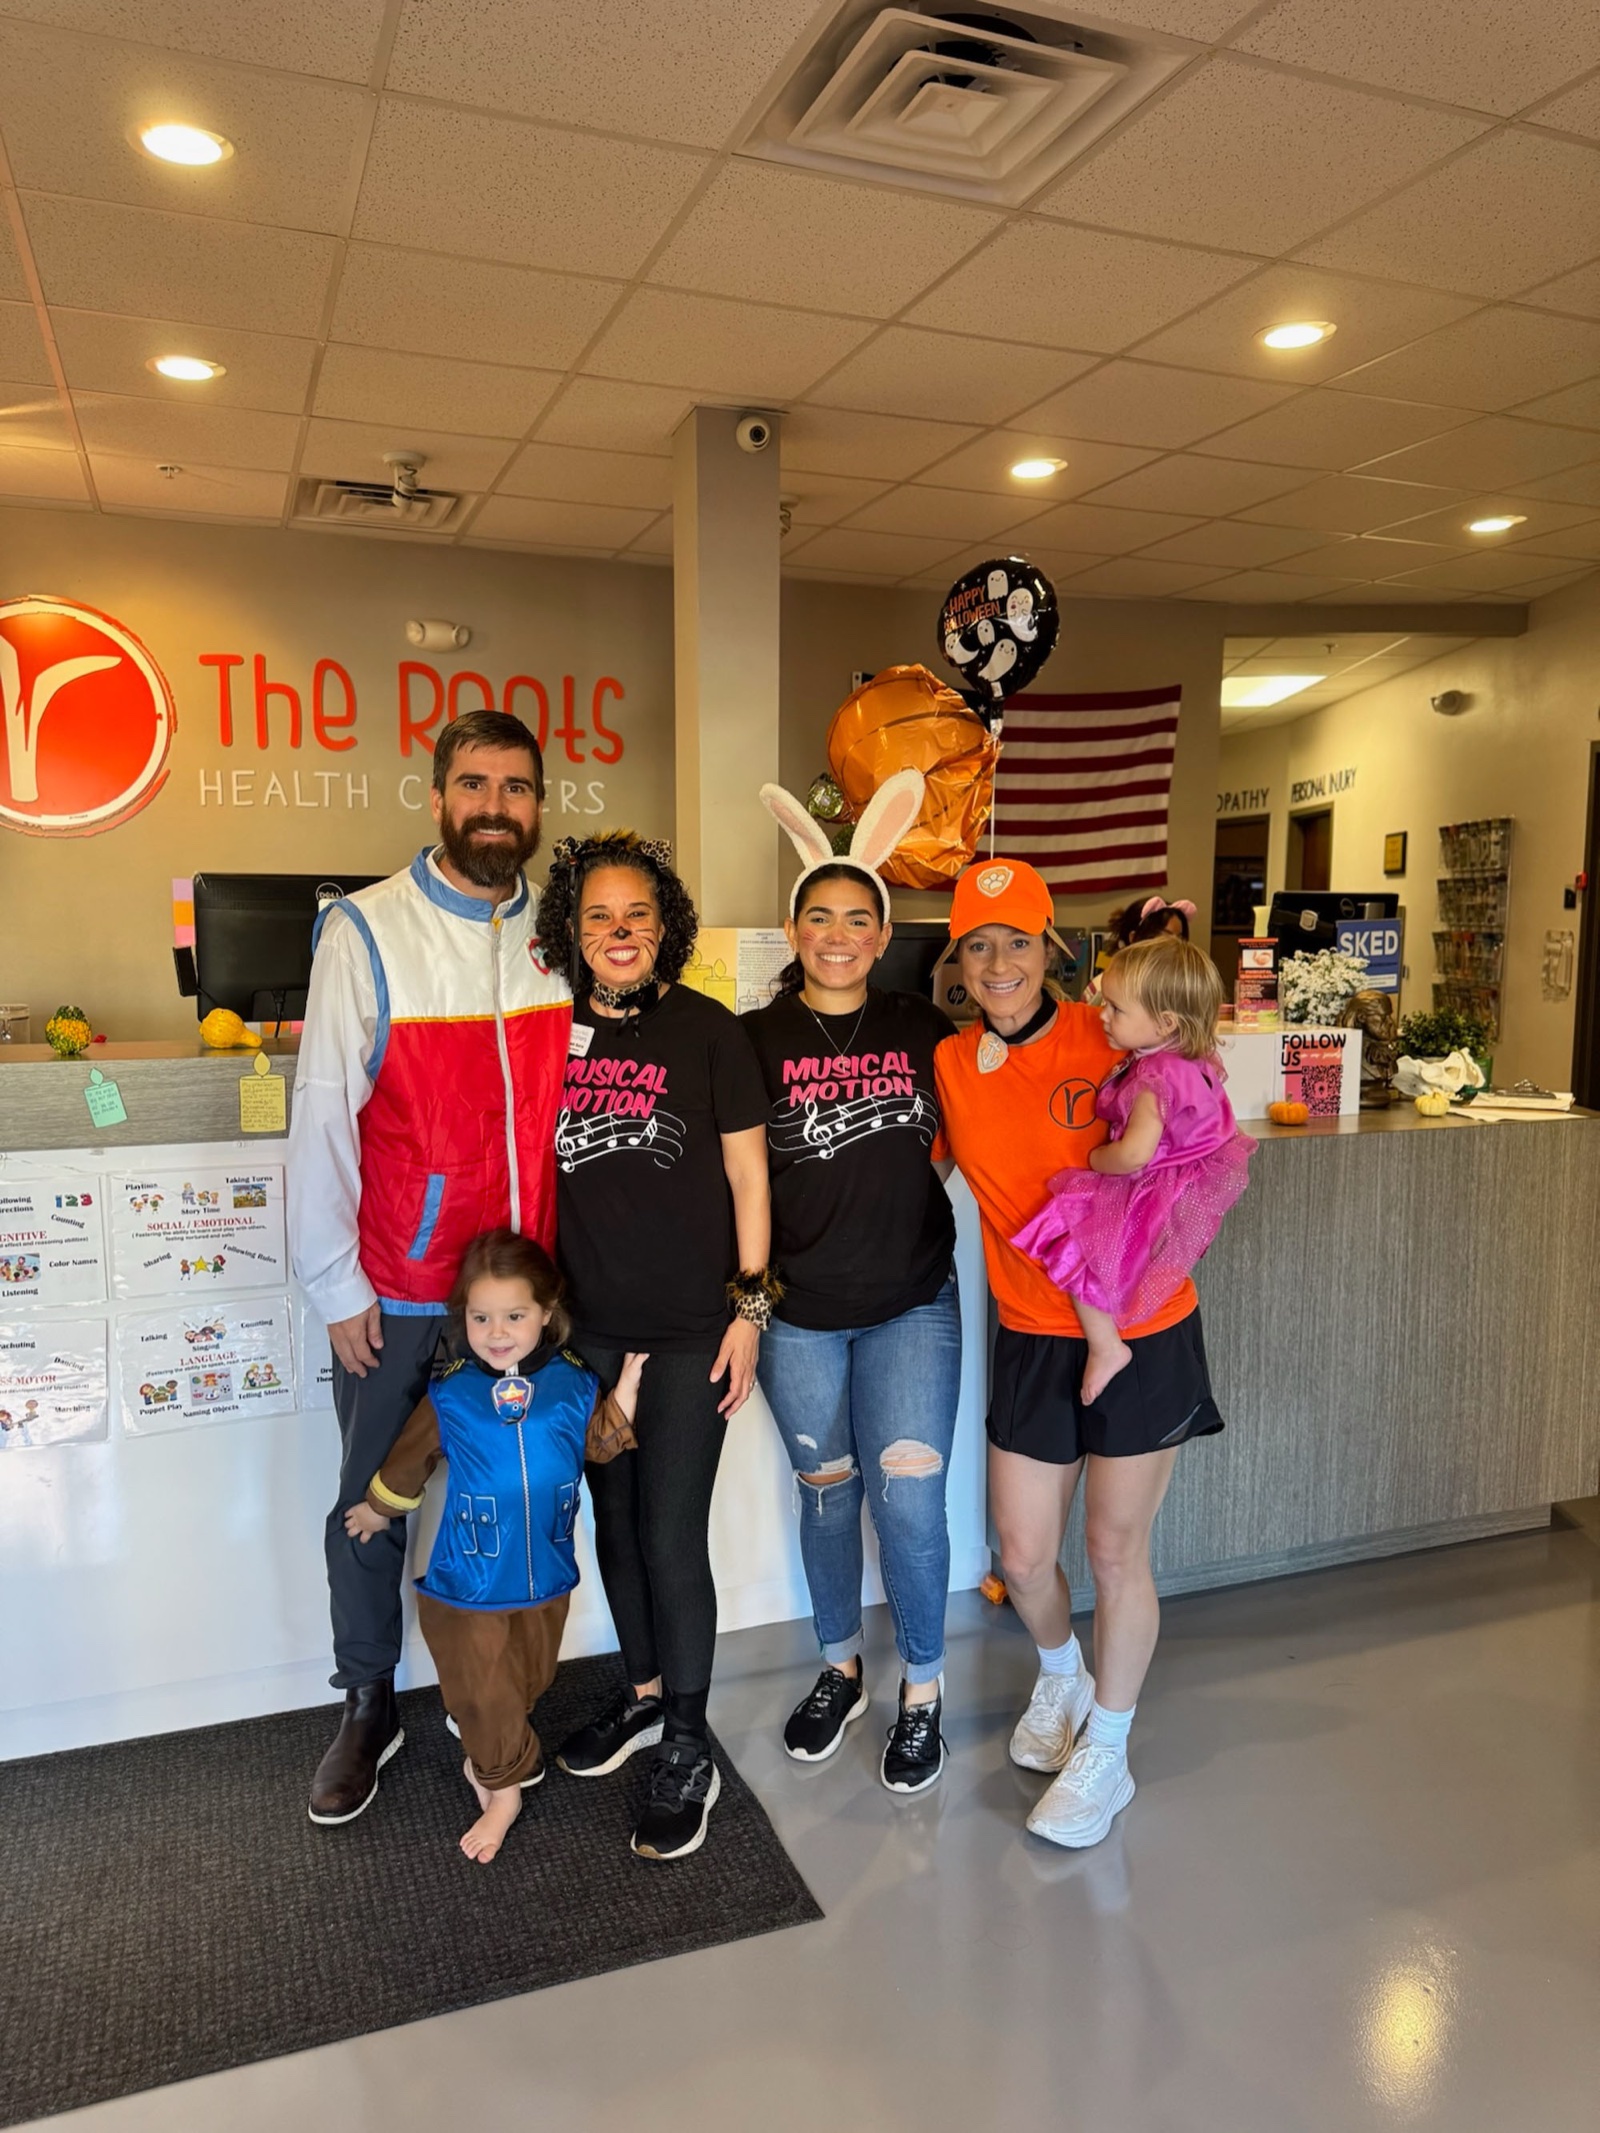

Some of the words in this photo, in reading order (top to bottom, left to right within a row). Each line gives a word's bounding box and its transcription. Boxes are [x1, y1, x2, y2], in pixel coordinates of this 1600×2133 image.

[949, 585, 985, 615] HAPPY
[200, 768, 370, 808] HEALTH
[1292, 775, 1325, 804] PERSONAL
[1330, 769, 1356, 794] INJURY
[1340, 930, 1398, 958] SKED
[1282, 1034, 1346, 1049] FOLLOW
[1281, 1051, 1301, 1066] US
[783, 1052, 917, 1085] MUSICAL
[790, 1077, 913, 1107] MOTION
[51, 1214, 85, 1229] Counting
[148, 1222, 185, 1231] SOCIAL
[194, 1217, 255, 1228] EMOTIONAL
[143, 1252, 172, 1268] Sharing
[223, 1244, 256, 1259] Following
[258, 1253, 277, 1263] Rules
[2, 1288, 38, 1297] Listening
[241, 1319, 273, 1328] Counting
[141, 1333, 168, 1342] Talking
[180, 1351, 237, 1366] LANGUAGE
[16, 1375, 56, 1385] MOTOR
[239, 1392, 262, 1400] Telling
[264, 1388, 289, 1396] Stories
[140, 1407, 165, 1415] Puppet
[183, 1408, 211, 1418] Naming
[213, 1404, 239, 1413] Objects
